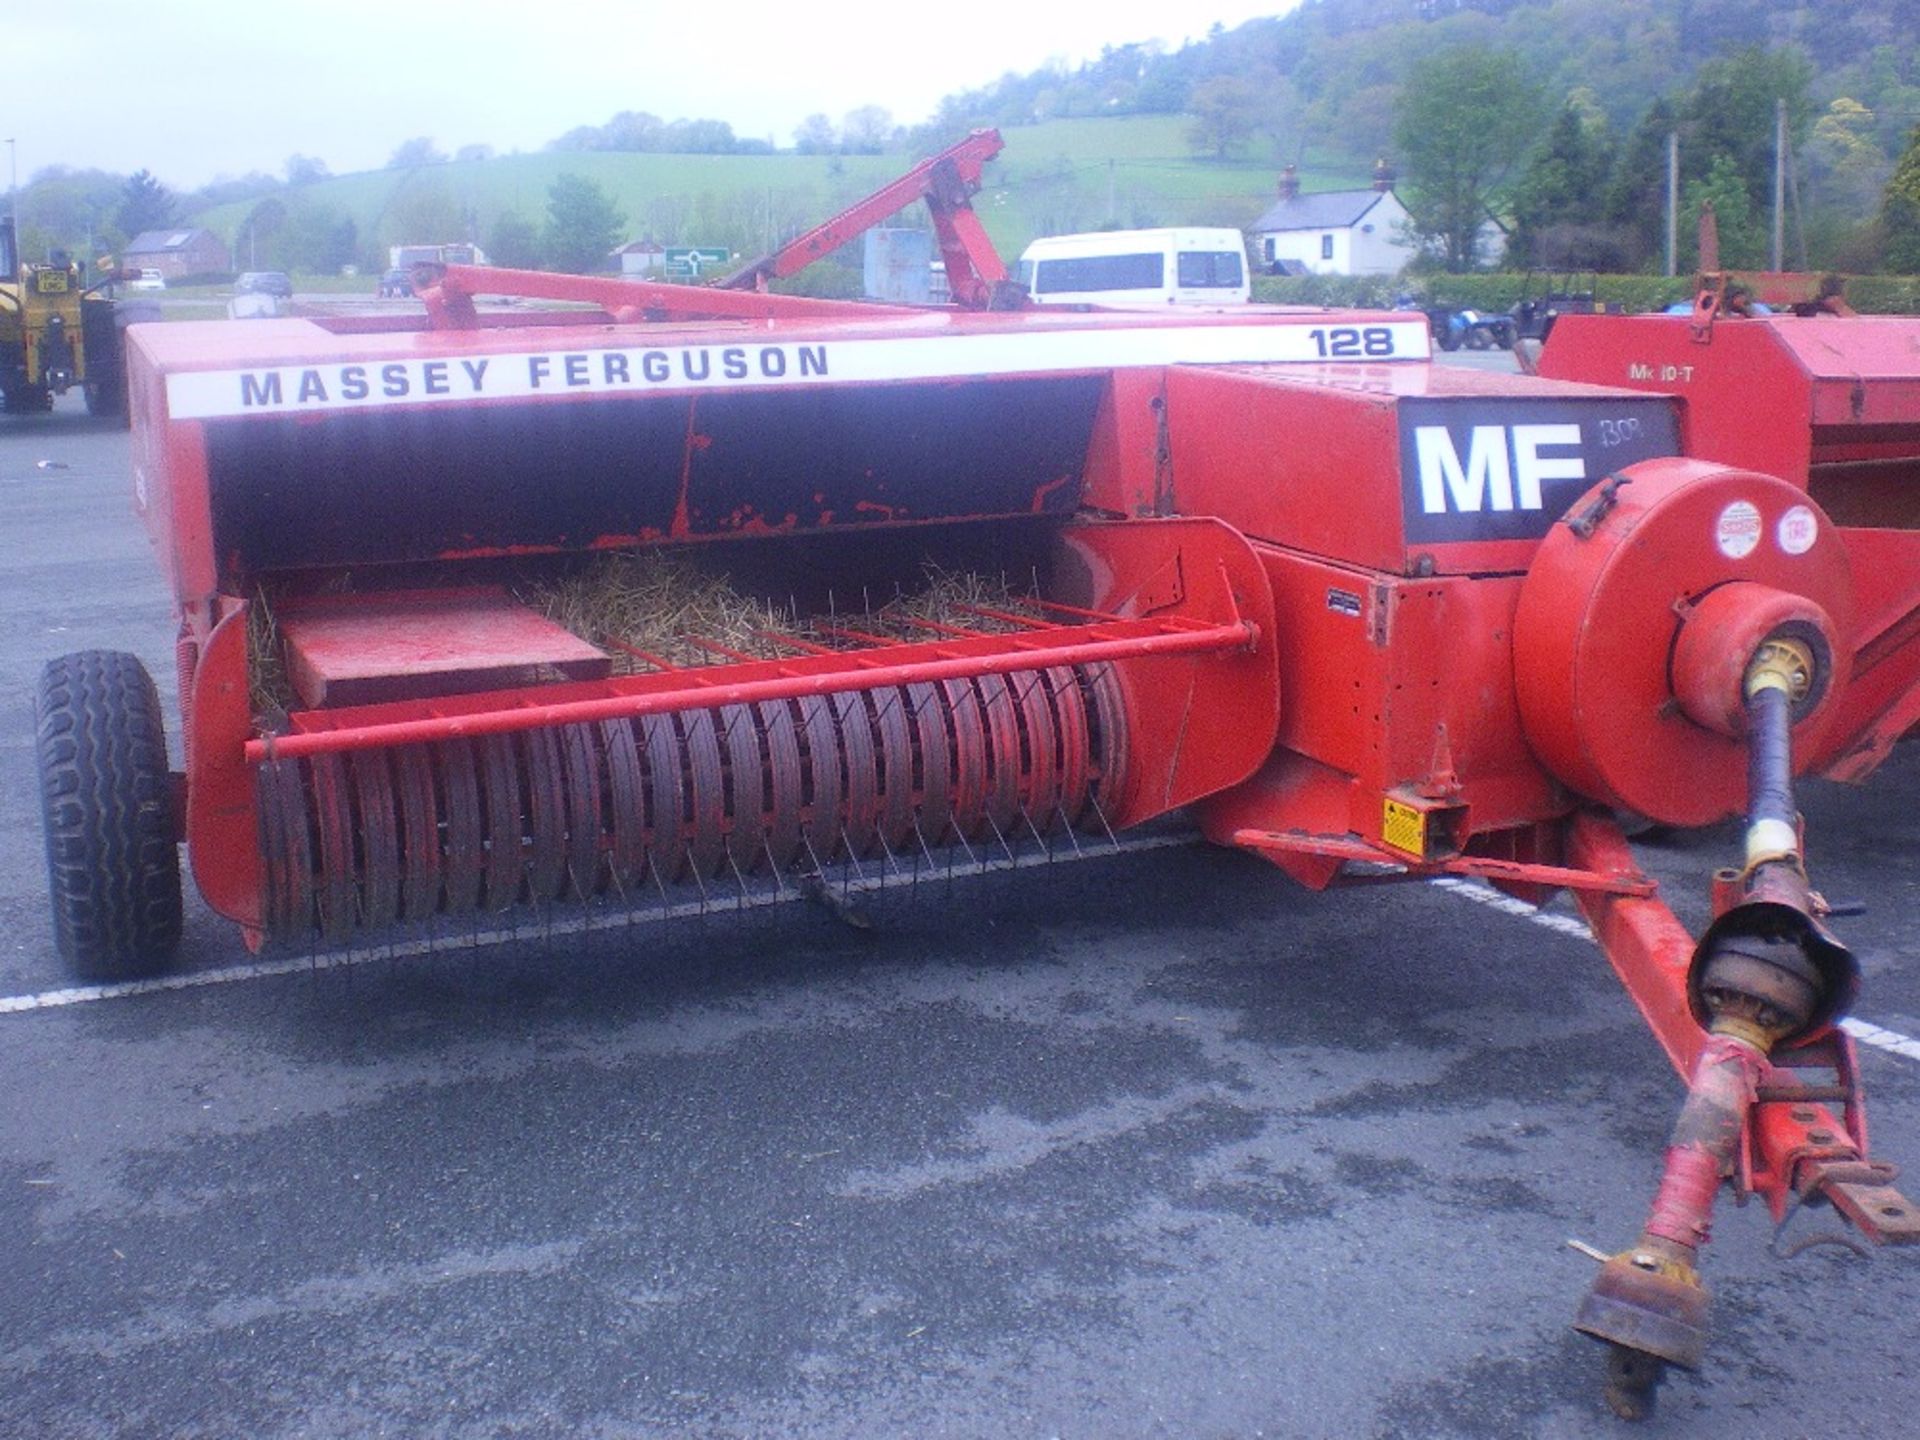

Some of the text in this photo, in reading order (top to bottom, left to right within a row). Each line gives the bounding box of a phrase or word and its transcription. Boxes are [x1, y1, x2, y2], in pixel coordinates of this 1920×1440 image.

[1309, 328, 1395, 357] 128
[240, 346, 829, 406] MASSEY FERGUSON
[1415, 424, 1586, 513] MF
